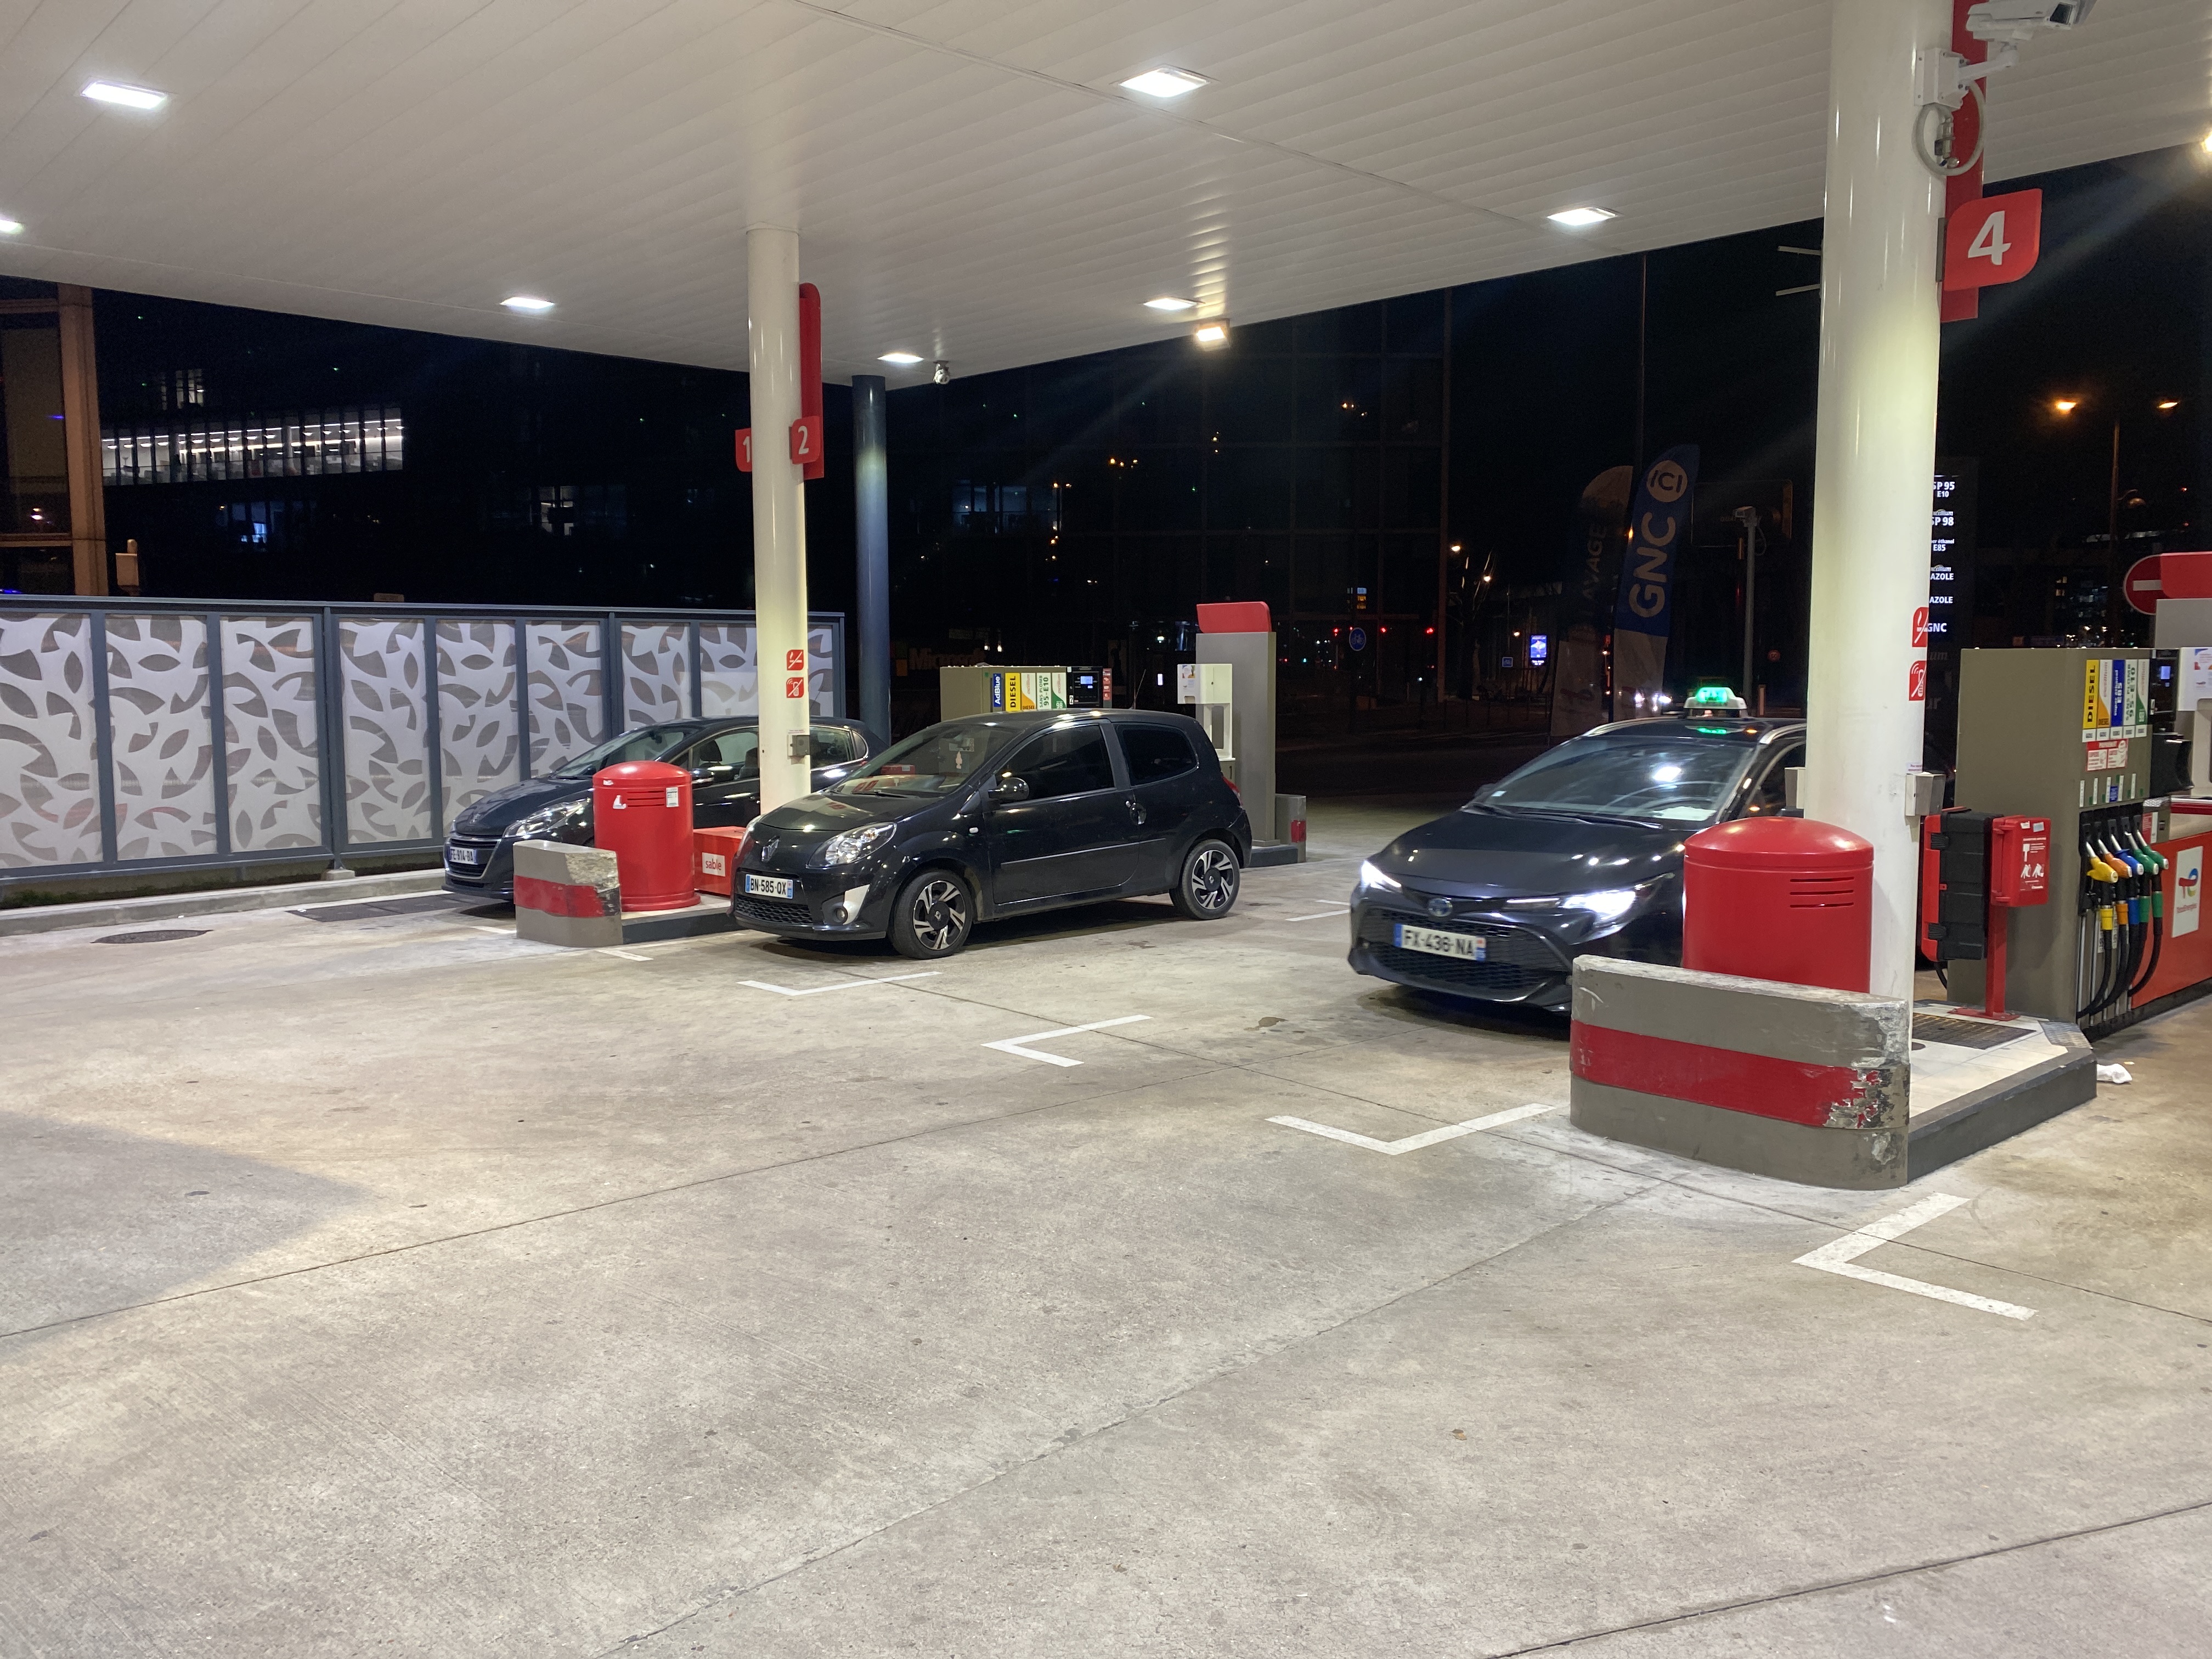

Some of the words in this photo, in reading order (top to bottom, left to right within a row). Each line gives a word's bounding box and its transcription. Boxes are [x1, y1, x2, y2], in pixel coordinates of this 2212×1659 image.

[1968, 210, 2012, 266] 4
[742, 436, 751, 463] 1
[798, 425, 809, 455] 2
[1944, 481, 1955, 490] 95
[1942, 516, 1954, 526] 98
[1629, 511, 1677, 618] GNC
[1927, 623, 1947, 632] GNC
[2087, 665, 2096, 723] DIESEL
[706, 858, 722, 871] sable
[1404, 929, 1475, 957] FX-436-NA
